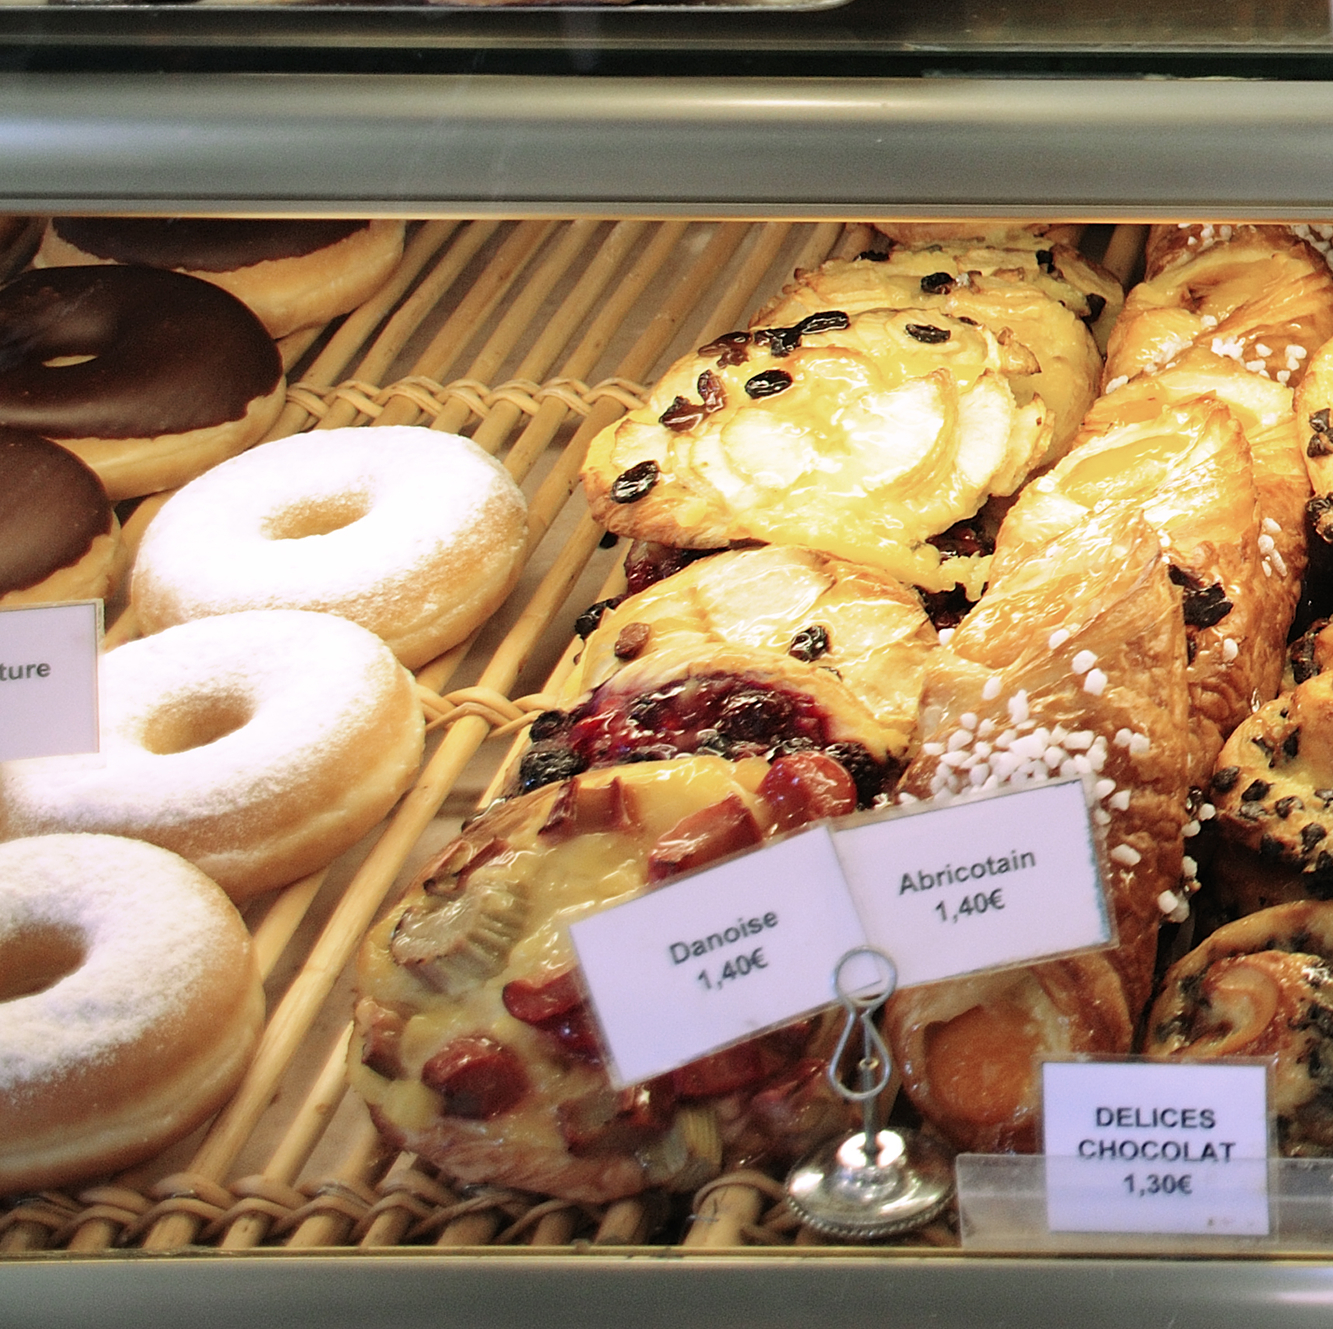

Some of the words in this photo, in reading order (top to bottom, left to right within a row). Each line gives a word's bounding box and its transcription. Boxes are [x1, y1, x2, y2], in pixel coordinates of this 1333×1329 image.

[899, 849, 1037, 896] Abricotain
[935, 888, 1006, 924] 1,40€
[669, 910, 779, 965] Danoise
[697, 947, 768, 992] 1,40€
[1095, 1106, 1217, 1129] DELICES
[1078, 1139, 1236, 1163] CHOCOLAT
[1124, 1174, 1193, 1197] 1,30€
